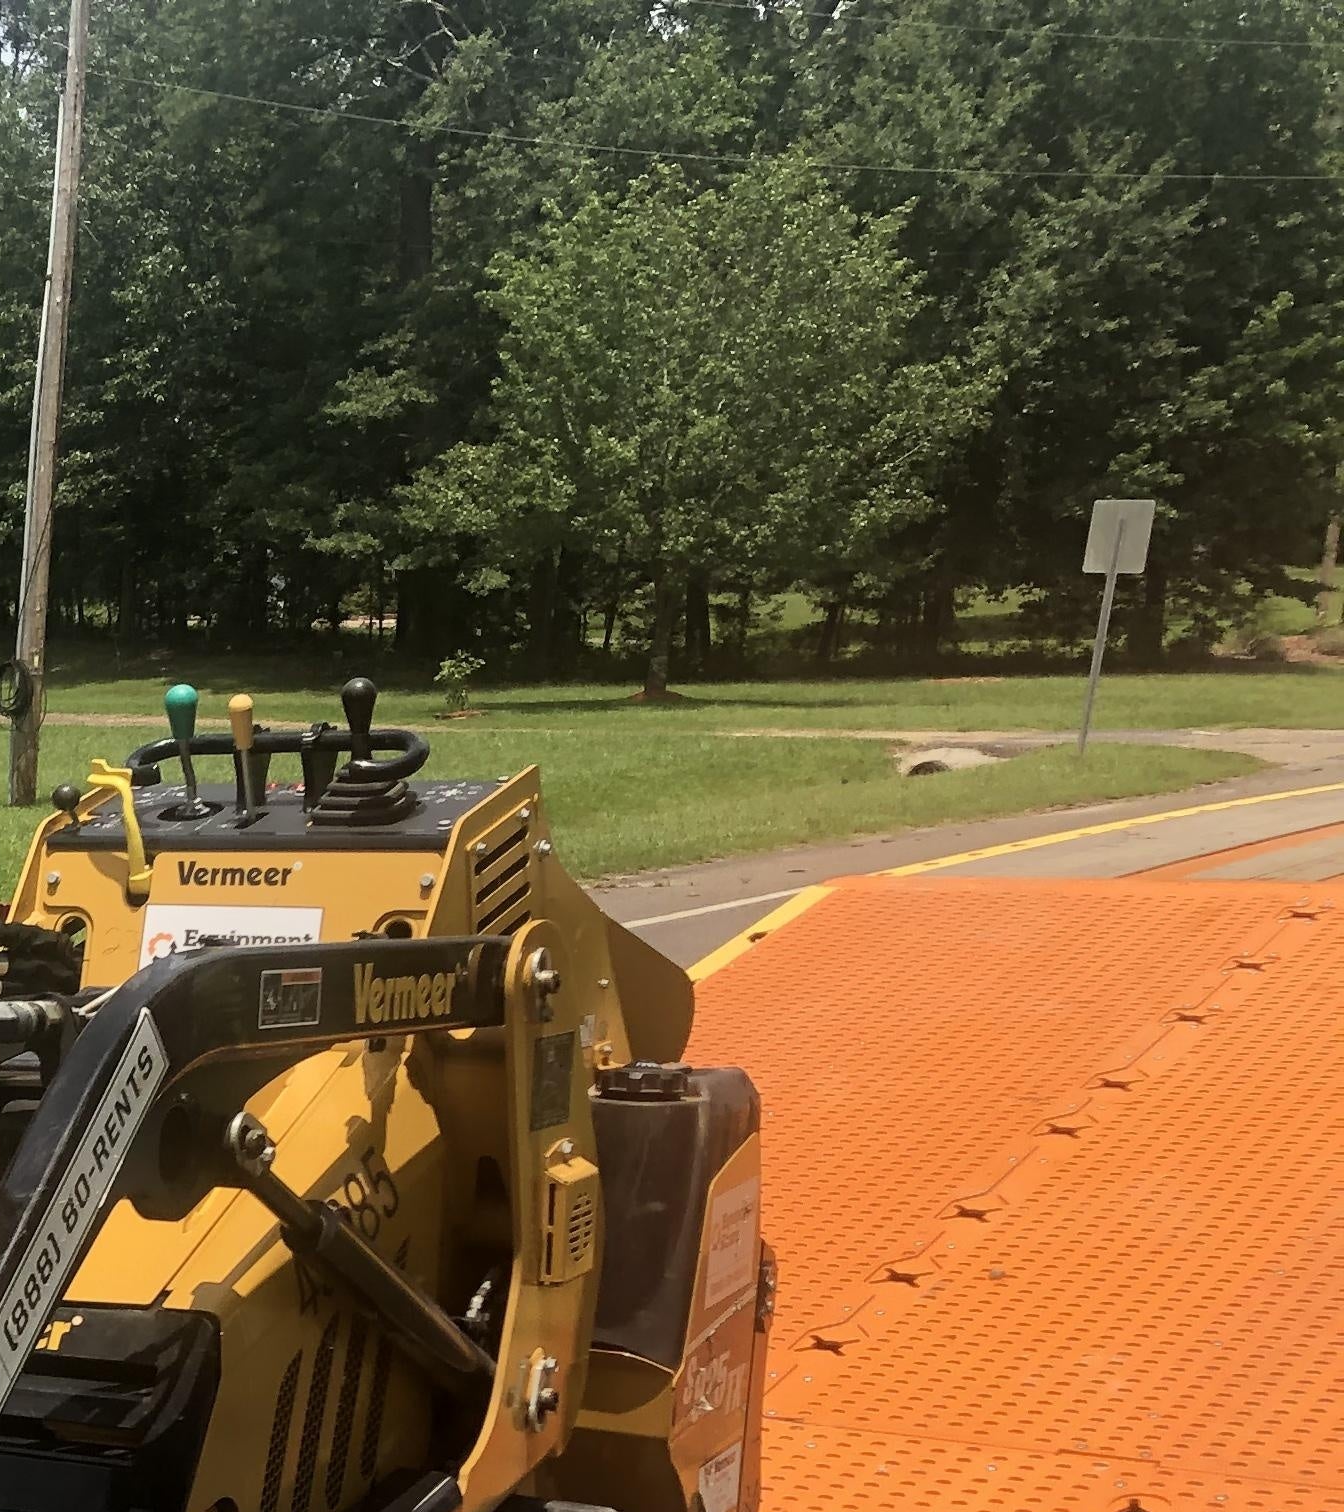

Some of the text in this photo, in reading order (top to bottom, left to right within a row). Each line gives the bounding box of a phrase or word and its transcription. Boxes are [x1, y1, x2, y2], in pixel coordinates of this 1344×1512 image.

[177, 861, 293, 887] Vermeer
[353, 962, 456, 1025] Vermeer
[62, 1045, 153, 1234] 80-RENTS
